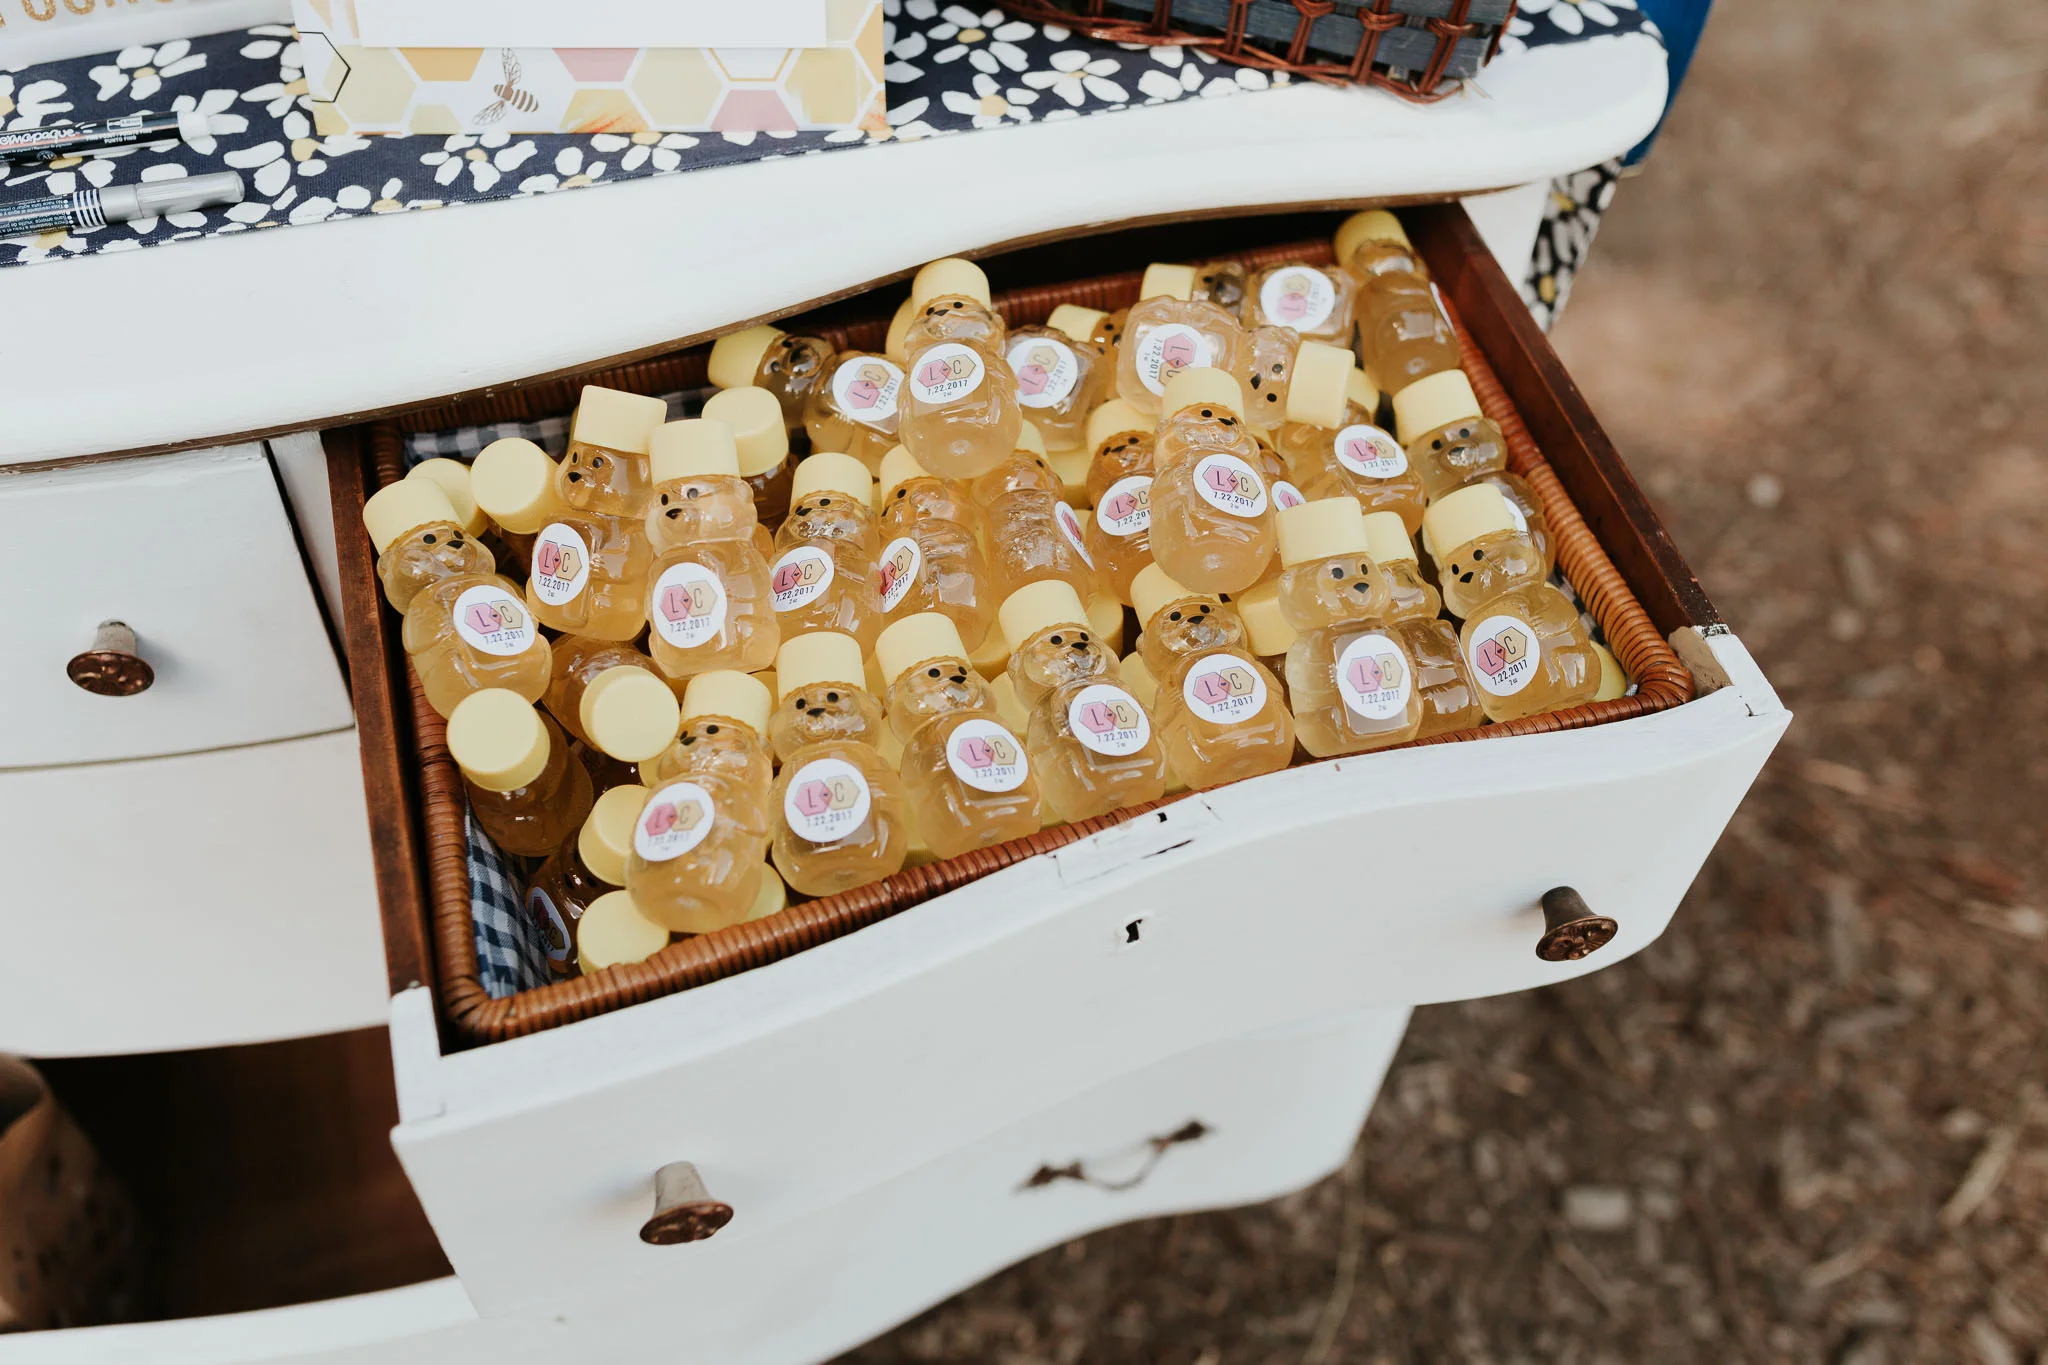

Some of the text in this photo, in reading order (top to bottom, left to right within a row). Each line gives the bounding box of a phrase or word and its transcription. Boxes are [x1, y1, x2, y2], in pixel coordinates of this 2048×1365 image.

[1213, 491, 1254, 508] 7.22.2017
[1117, 510, 1150, 528] 7.22.201
[775, 586, 815, 602] 7.22.2017
[1492, 659, 1529, 685] 7.22.2017
[1210, 695, 1253, 714] 7.22.2017
